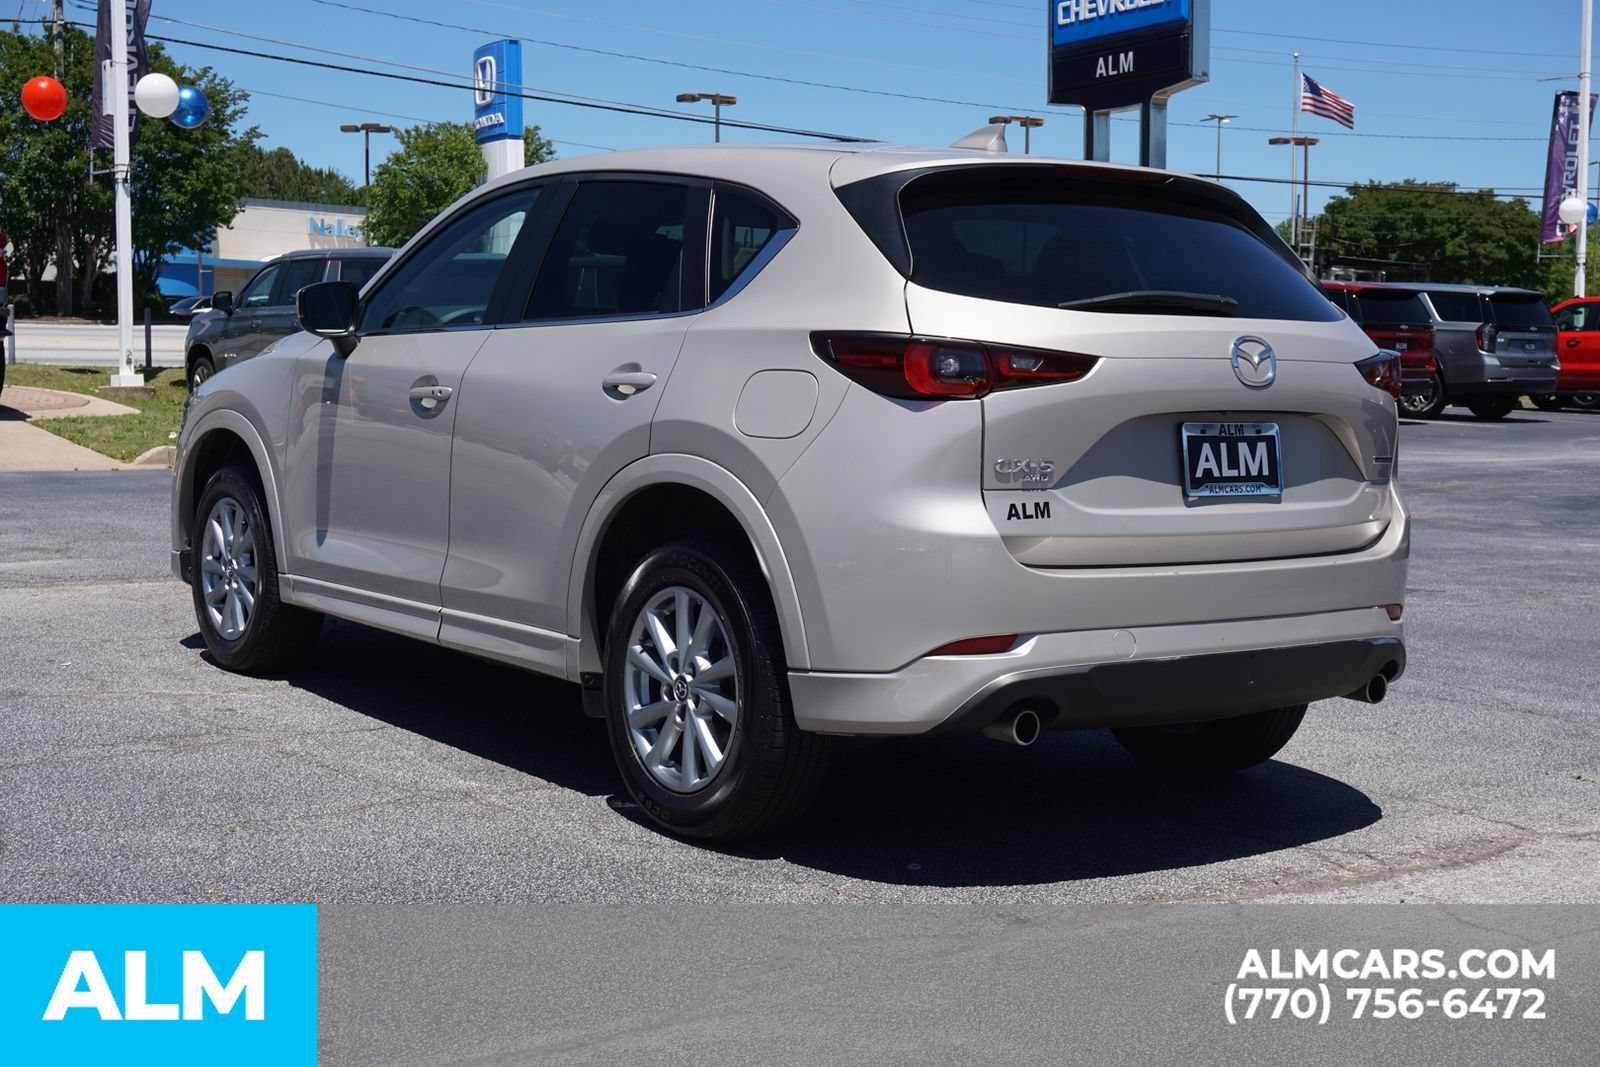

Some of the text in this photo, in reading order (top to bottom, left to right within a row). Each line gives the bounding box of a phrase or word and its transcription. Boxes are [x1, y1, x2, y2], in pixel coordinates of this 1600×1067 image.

[1057, 0, 1165, 25] CHEVR
[1095, 51, 1134, 78] ALM
[1218, 424, 1244, 435] ALM
[994, 459, 1055, 473] CX-5
[1195, 442, 1269, 477] ALM
[1208, 485, 1262, 494] ALMCARS.COM
[1007, 501, 1051, 520] ALM
